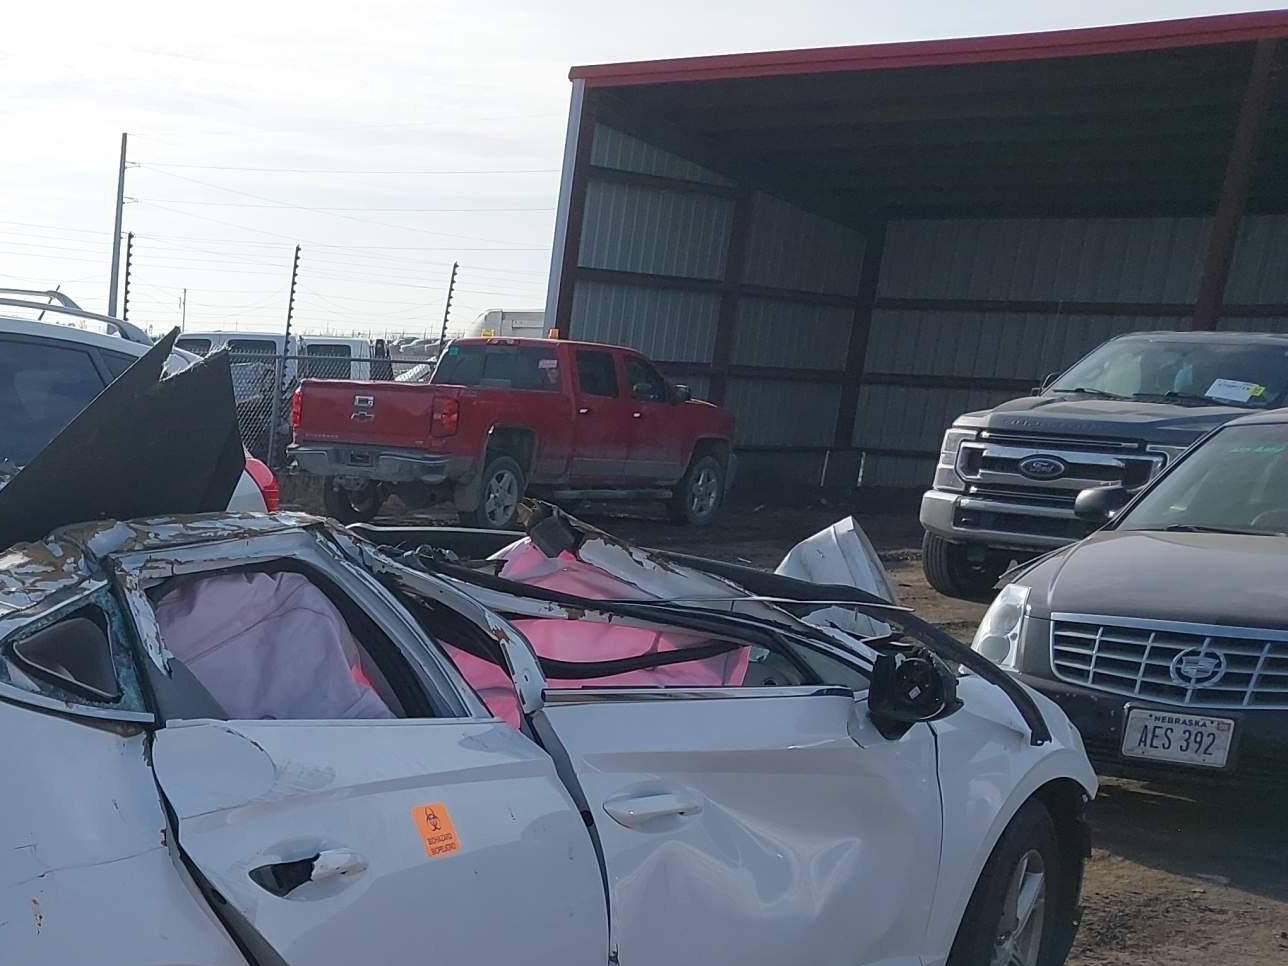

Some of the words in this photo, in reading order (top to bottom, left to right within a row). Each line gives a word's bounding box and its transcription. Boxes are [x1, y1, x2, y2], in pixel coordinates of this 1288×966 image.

[1154, 715, 1208, 728] NEBRASKA
[1138, 724, 1174, 750] AES
[1179, 729, 1217, 756] 392
